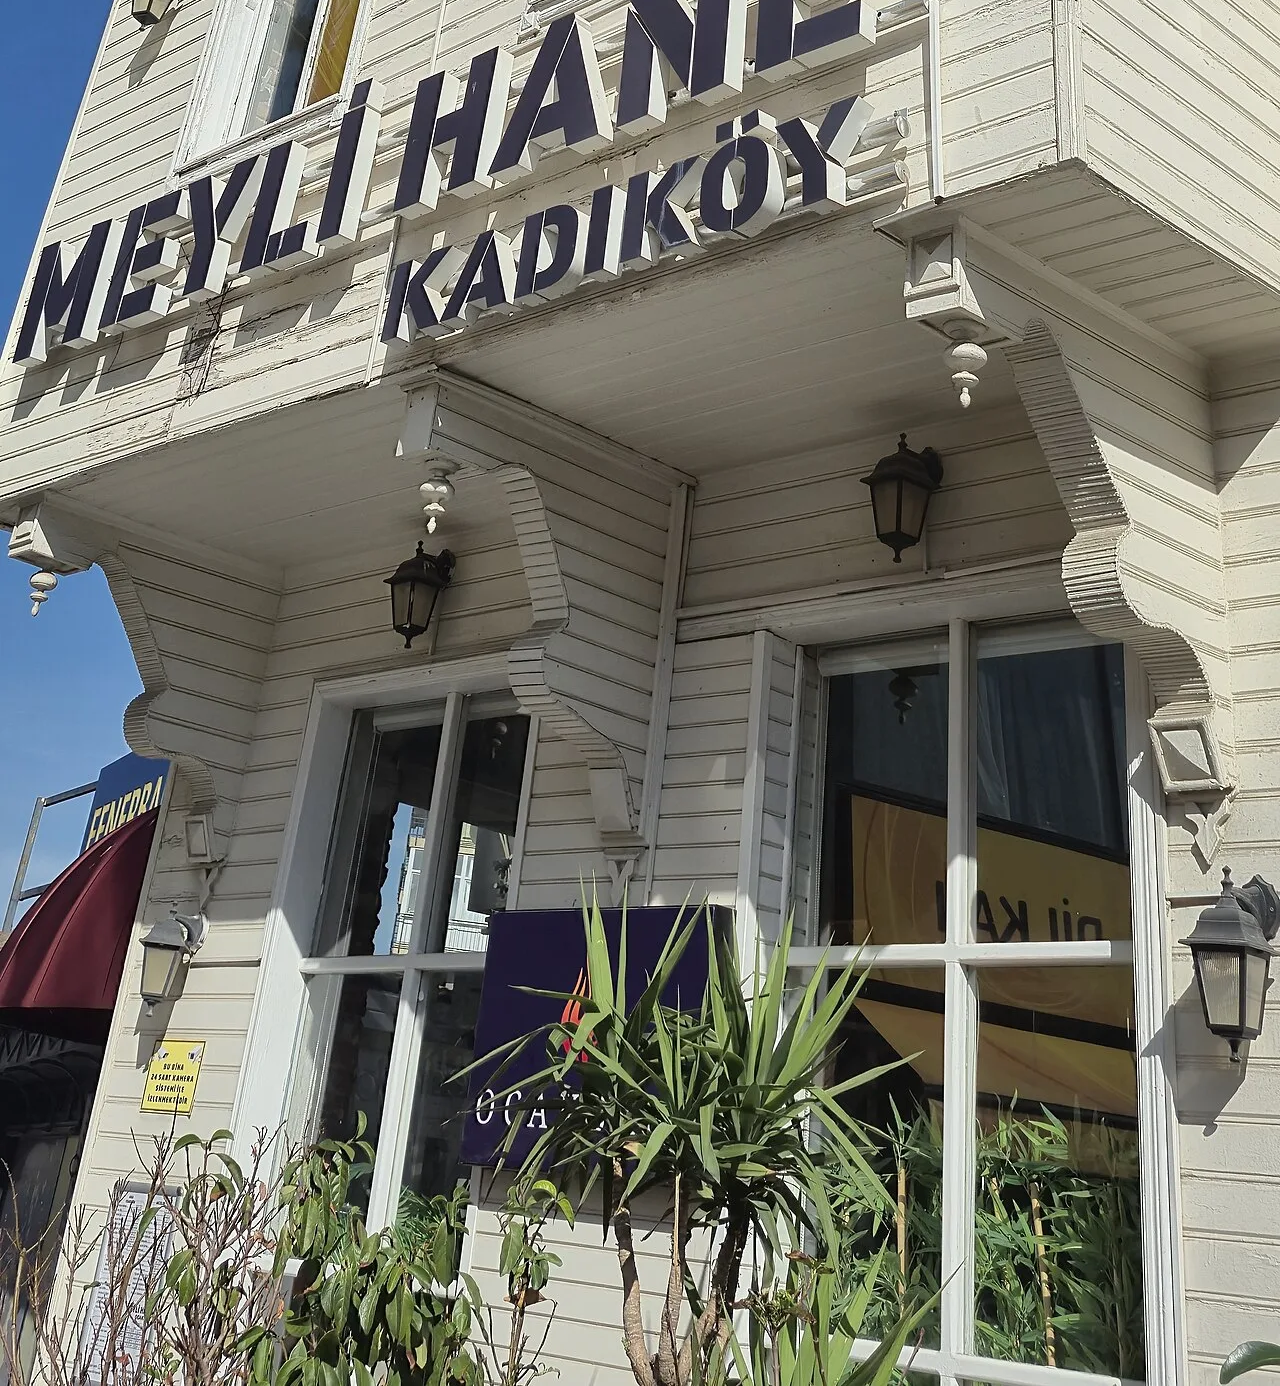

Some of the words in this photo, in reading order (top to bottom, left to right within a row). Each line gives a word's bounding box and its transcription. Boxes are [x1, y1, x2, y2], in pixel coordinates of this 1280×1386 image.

[13, 78, 378, 366] MEYLİ
[381, 95, 864, 345] KADIKÖY
[171, 1062, 184, 1071] BİNA
[150, 1073, 158, 1081] 24
[172, 1074, 194, 1083] KAMERA
[147, 1093, 188, 1105] İZLENMEKTDİR
